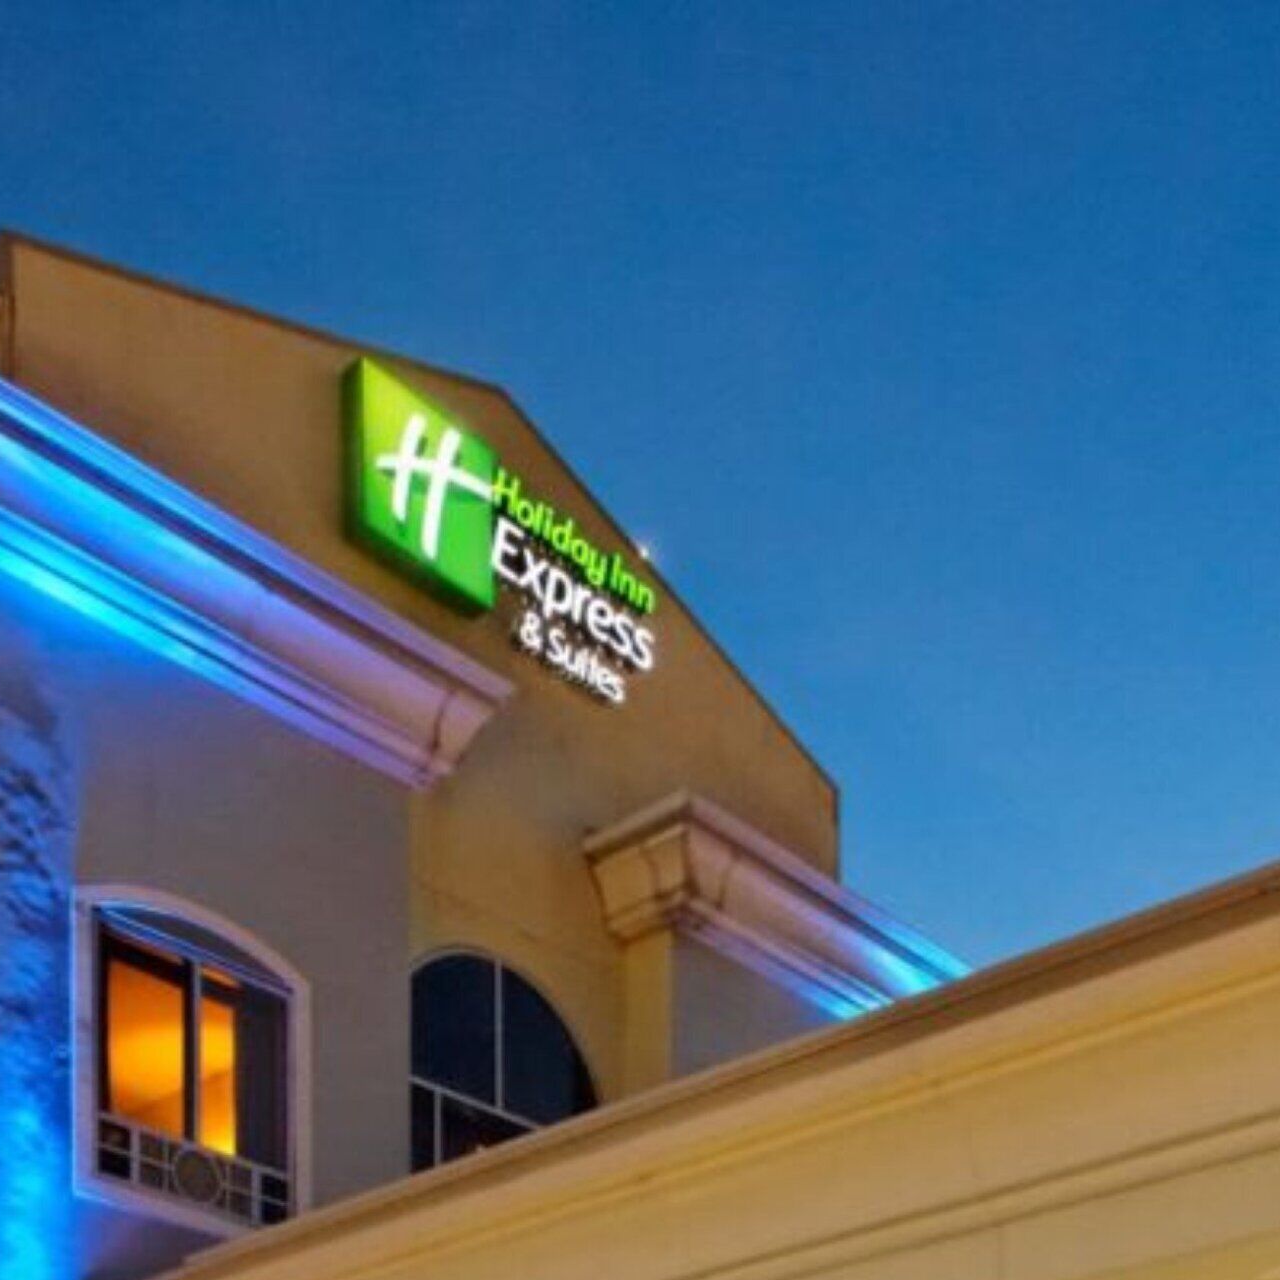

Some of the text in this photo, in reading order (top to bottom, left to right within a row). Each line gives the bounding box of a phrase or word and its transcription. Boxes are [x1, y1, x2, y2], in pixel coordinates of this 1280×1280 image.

[491, 467, 656, 614] Holiday Inn
[491, 517, 656, 672] Express
[520, 611, 626, 703] & Suites
